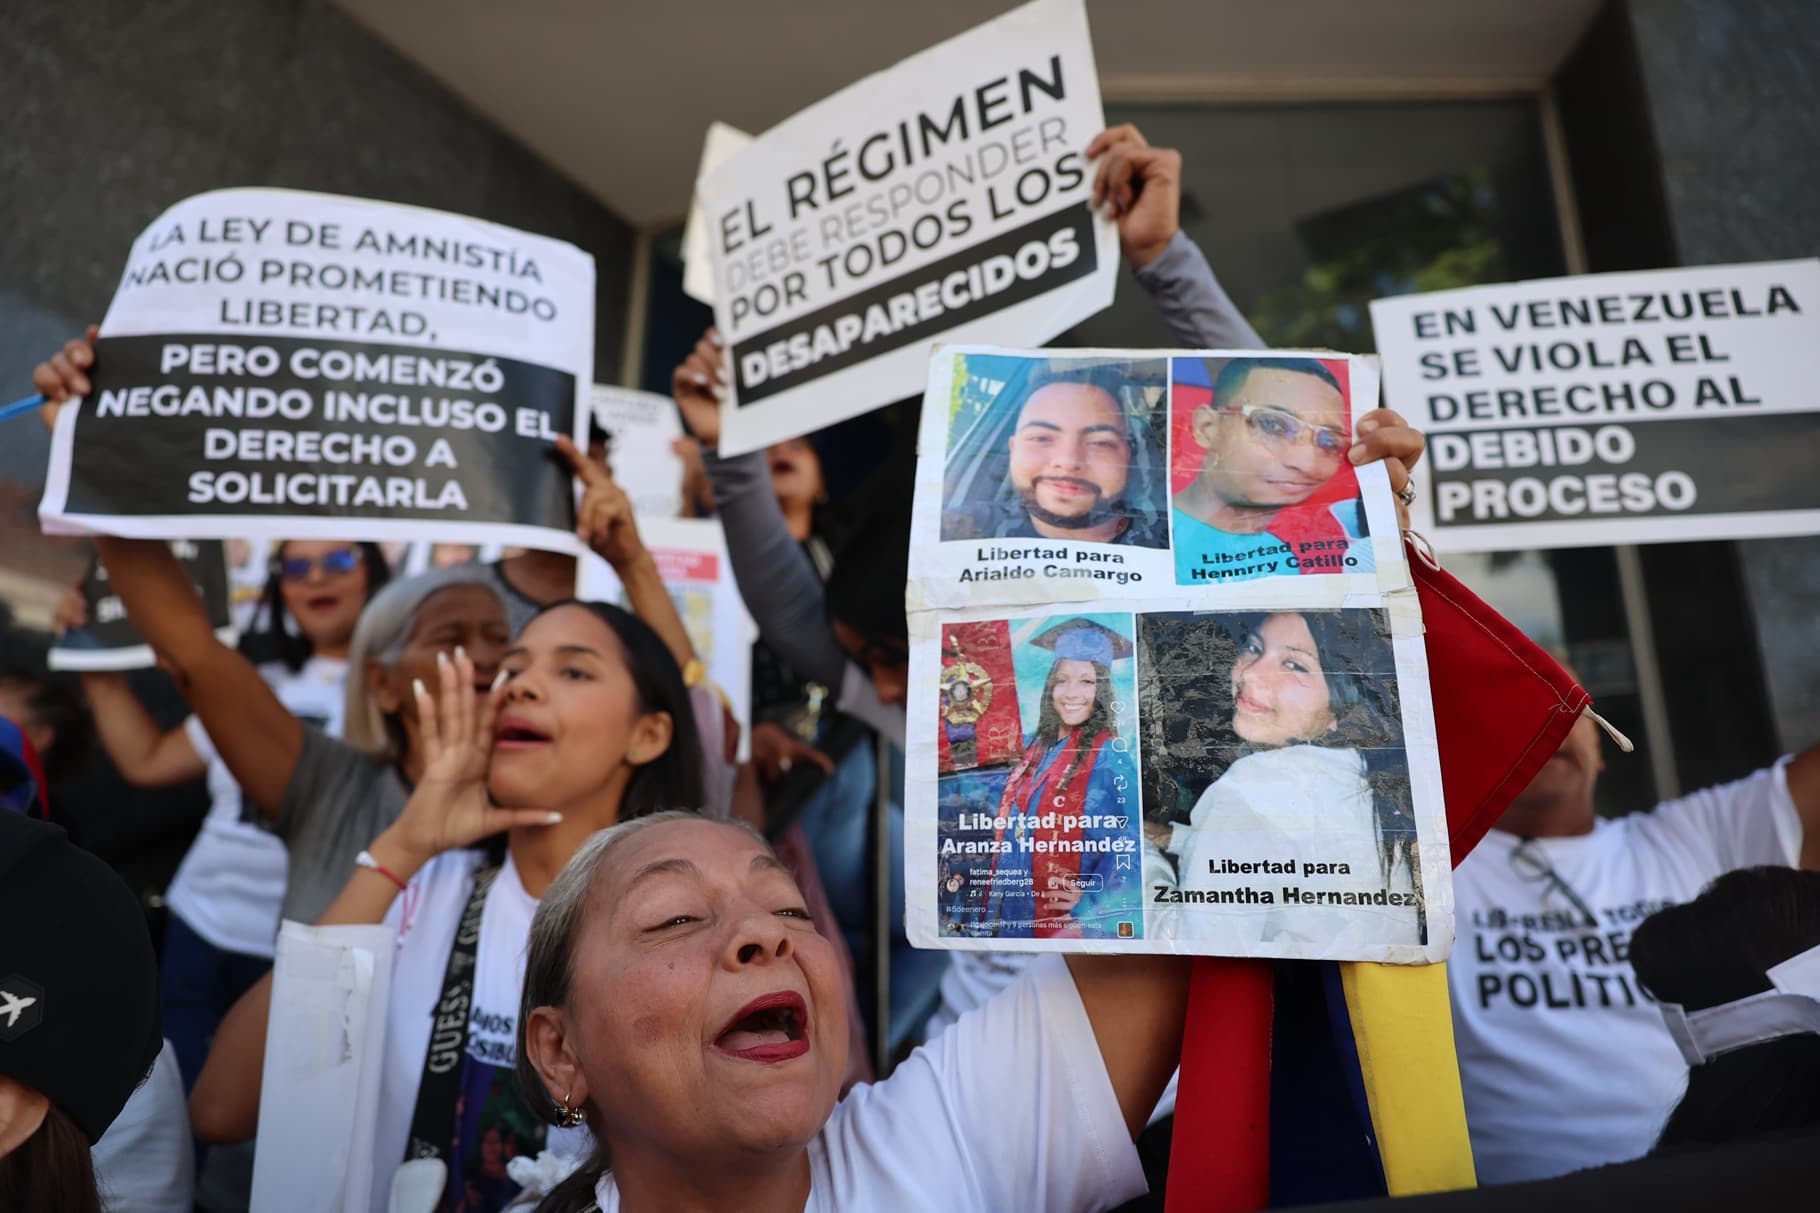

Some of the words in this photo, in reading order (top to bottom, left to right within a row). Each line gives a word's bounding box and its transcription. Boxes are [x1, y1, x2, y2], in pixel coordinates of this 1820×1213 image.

[718, 198, 772, 254] EL
[785, 55, 1067, 219] RÉGIMEN
[725, 229, 809, 293] DEBE
[820, 117, 1068, 249] RESPONDER
[150, 223, 185, 254] LA
[200, 218, 271, 246] LEY
[285, 220, 340, 249] DE
[356, 229, 543, 283] AMNISTÍA
[731, 273, 807, 331] POR
[817, 200, 973, 290] TODOS
[988, 151, 1085, 222] LOS
[124, 255, 245, 288] NACIÓ
[260, 259, 557, 321] PROMETIENDO
[741, 227, 1081, 388] DESAPARECIDOS
[219, 299, 438, 341] LIBERTAD,
[1413, 307, 1477, 340] EN
[1490, 285, 1801, 332] VENEZUELA
[160, 343, 281, 377] PERO
[290, 347, 505, 393] COMENZÓ
[1421, 348, 1480, 382] SE
[1493, 338, 1653, 377] VIOLA
[1667, 333, 1730, 363] EL
[95, 386, 313, 420] NEGANDO
[323, 394, 507, 432] INCLUSO
[516, 406, 560, 442] EL
[1427, 380, 1676, 423] DERECHO
[1694, 376, 1762, 407] AL
[204, 428, 417, 466] DERECHO
[424, 439, 460, 469] A
[1430, 425, 1637, 472] DEBIDO
[188, 471, 469, 511] SOLICITARLA
[1436, 471, 1698, 523] PROCESO
[977, 546, 1068, 562] Libertad
[1075, 549, 1125, 566] para
[1191, 559, 1278, 581] Hennrry
[1285, 552, 1358, 569] Catillo
[1201, 544, 1292, 565] Libertad
[1299, 537, 1350, 554] para
[959, 564, 1036, 583] Arialdo
[1042, 564, 1143, 584] Camargo
[959, 812, 1056, 831] Libertad
[1063, 815, 1119, 832] para
[941, 838, 1012, 854] Aranza
[1020, 837, 1137, 854] Hernandez
[1070, 878, 1096, 889] Seguir
[1208, 859, 1297, 875] Libertad
[1303, 860, 1352, 878] para
[1153, 885, 1275, 905] Zamantha
[1282, 887, 1418, 907] Hernandez
[1475, 934, 1547, 964] LOS
